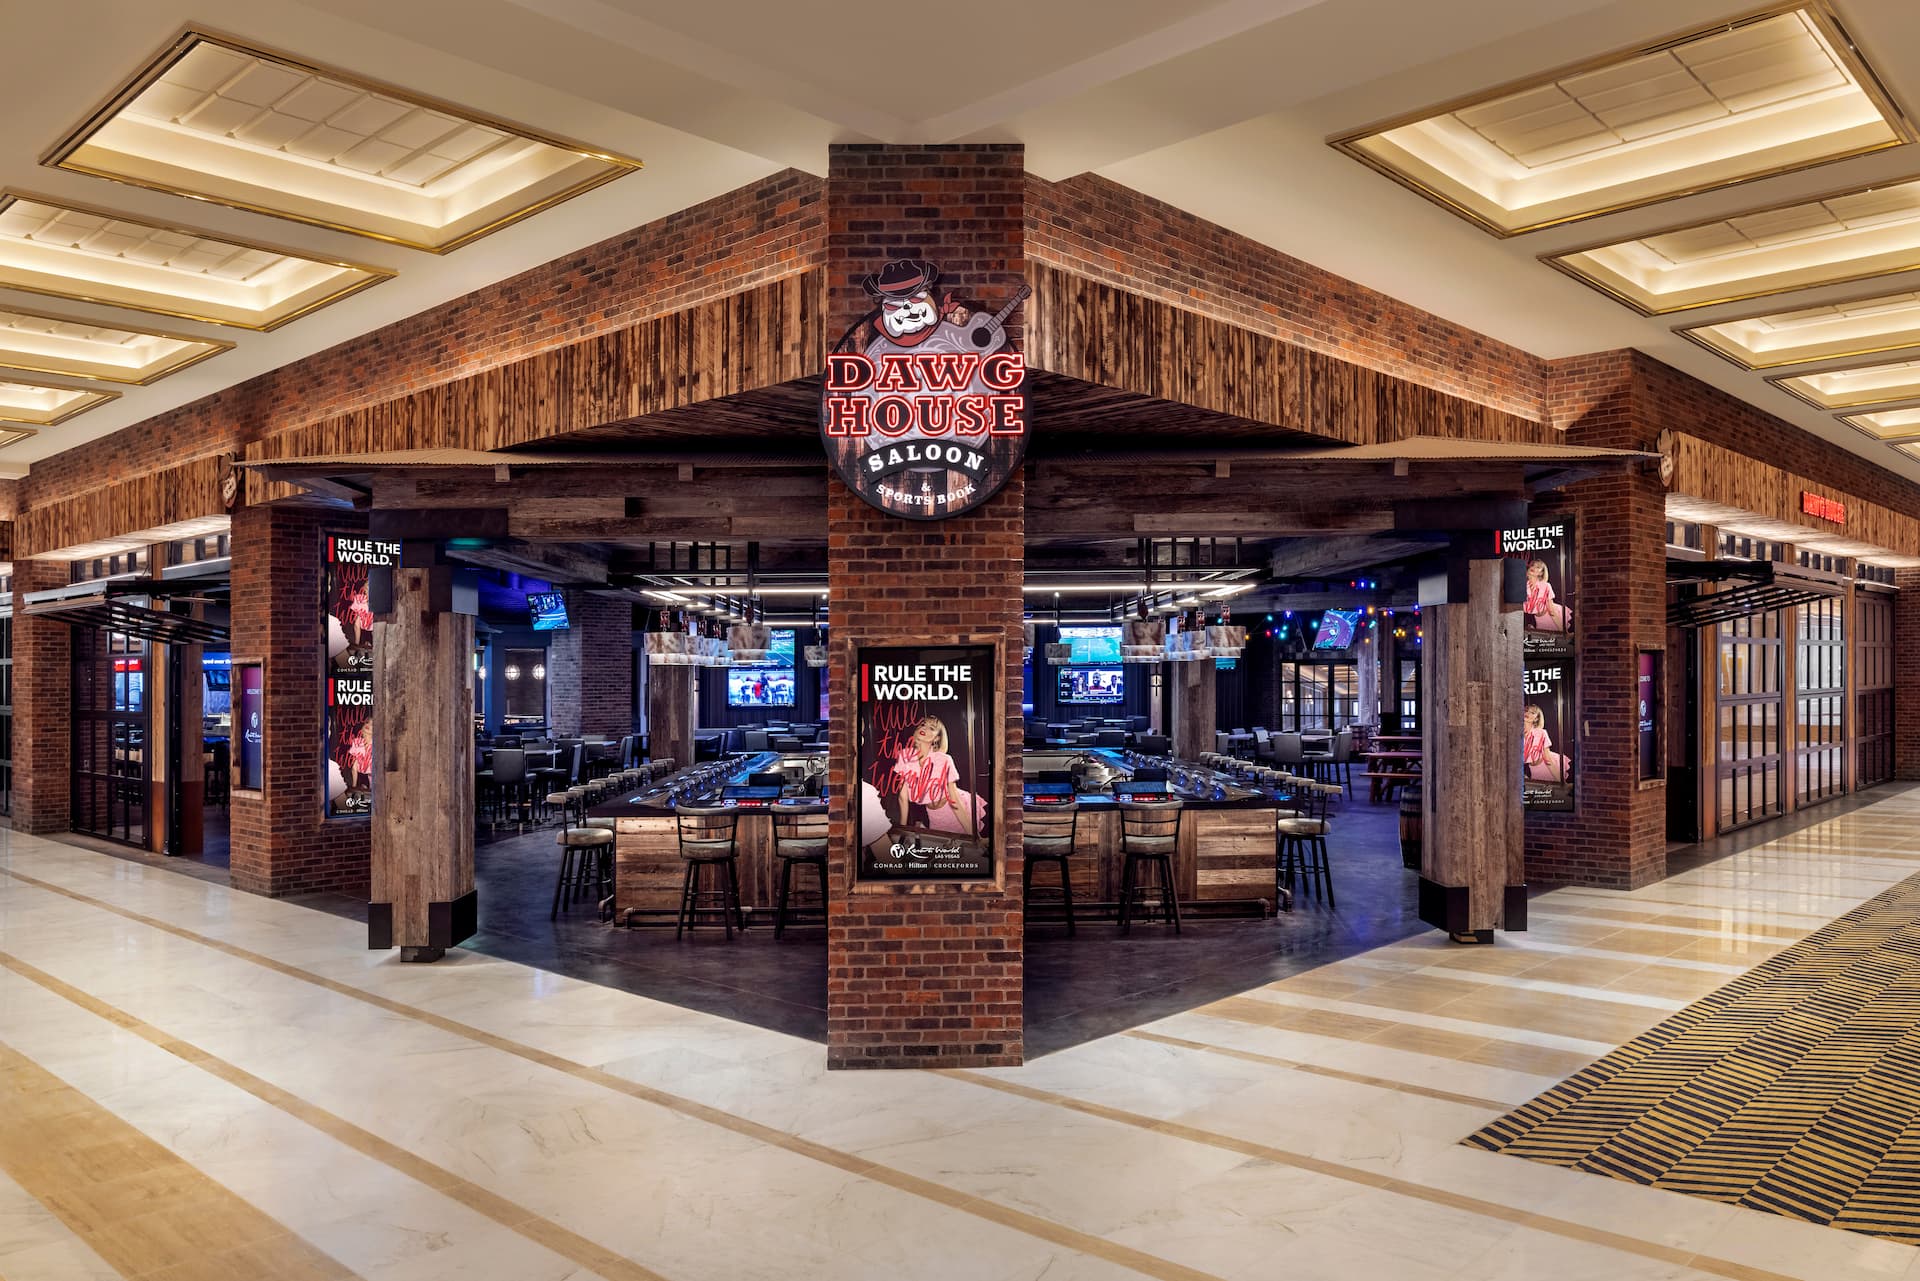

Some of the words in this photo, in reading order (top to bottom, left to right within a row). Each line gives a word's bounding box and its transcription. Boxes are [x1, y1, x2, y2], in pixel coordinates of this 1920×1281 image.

[827, 353, 1025, 392] DAWG
[827, 396, 1025, 436] HOUSE
[868, 444, 984, 472] SALOON
[876, 484, 932, 505] SPORTS
[937, 483, 976, 504] BOOK
[921, 482, 931, 492] &
[1503, 527, 1535, 541] RULE
[1537, 525, 1564, 538] THE
[337, 538, 373, 552] RULE
[375, 541, 401, 556] THE
[1502, 538, 1556, 553] WORLD.
[337, 550, 393, 566] WORLD.
[874, 665, 926, 682] RULE
[931, 665, 971, 682] THE
[1532, 667, 1561, 681] THE
[337, 679, 372, 693] RULE
[874, 684, 959, 701] WORLD.
[1523, 682, 1552, 695] RLD.
